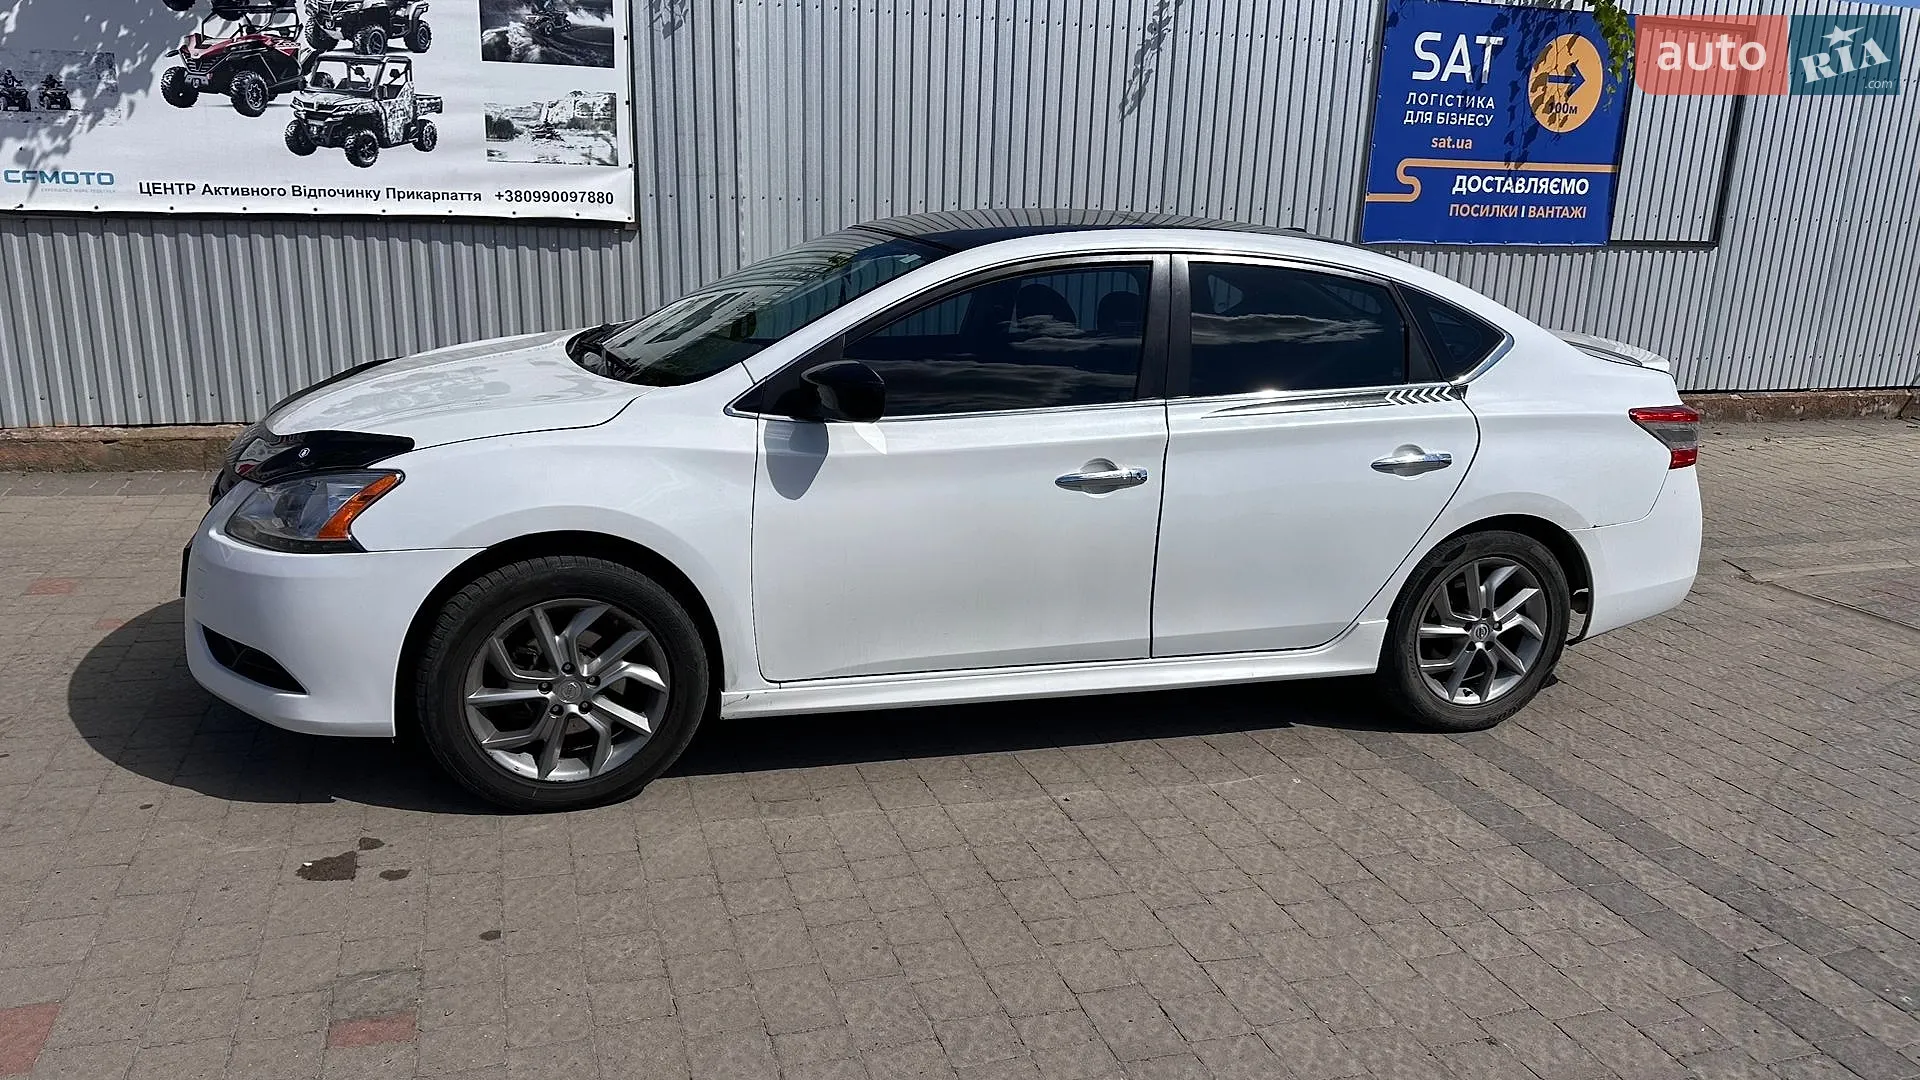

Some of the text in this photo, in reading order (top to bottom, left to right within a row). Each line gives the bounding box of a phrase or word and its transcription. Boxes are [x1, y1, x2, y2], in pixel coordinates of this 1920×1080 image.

[1412, 31, 1504, 84] SAT
[1406, 92, 1495, 109] ЛОГІСТИКА
[1403, 110, 1494, 127] ДЛЯ БІЗНЕСУ
[1431, 136, 1473, 149] sat.ua
[3, 169, 115, 185] CFMOTO
[1451, 175, 1589, 195] ДОСТАВЛЯЄМО
[138, 181, 614, 204] ЦЕНТР Активного Відпочинку Прикарпаття +380990097880
[1449, 203, 1587, 219] ПОСИЛКИ І ВАНТАЖІ
